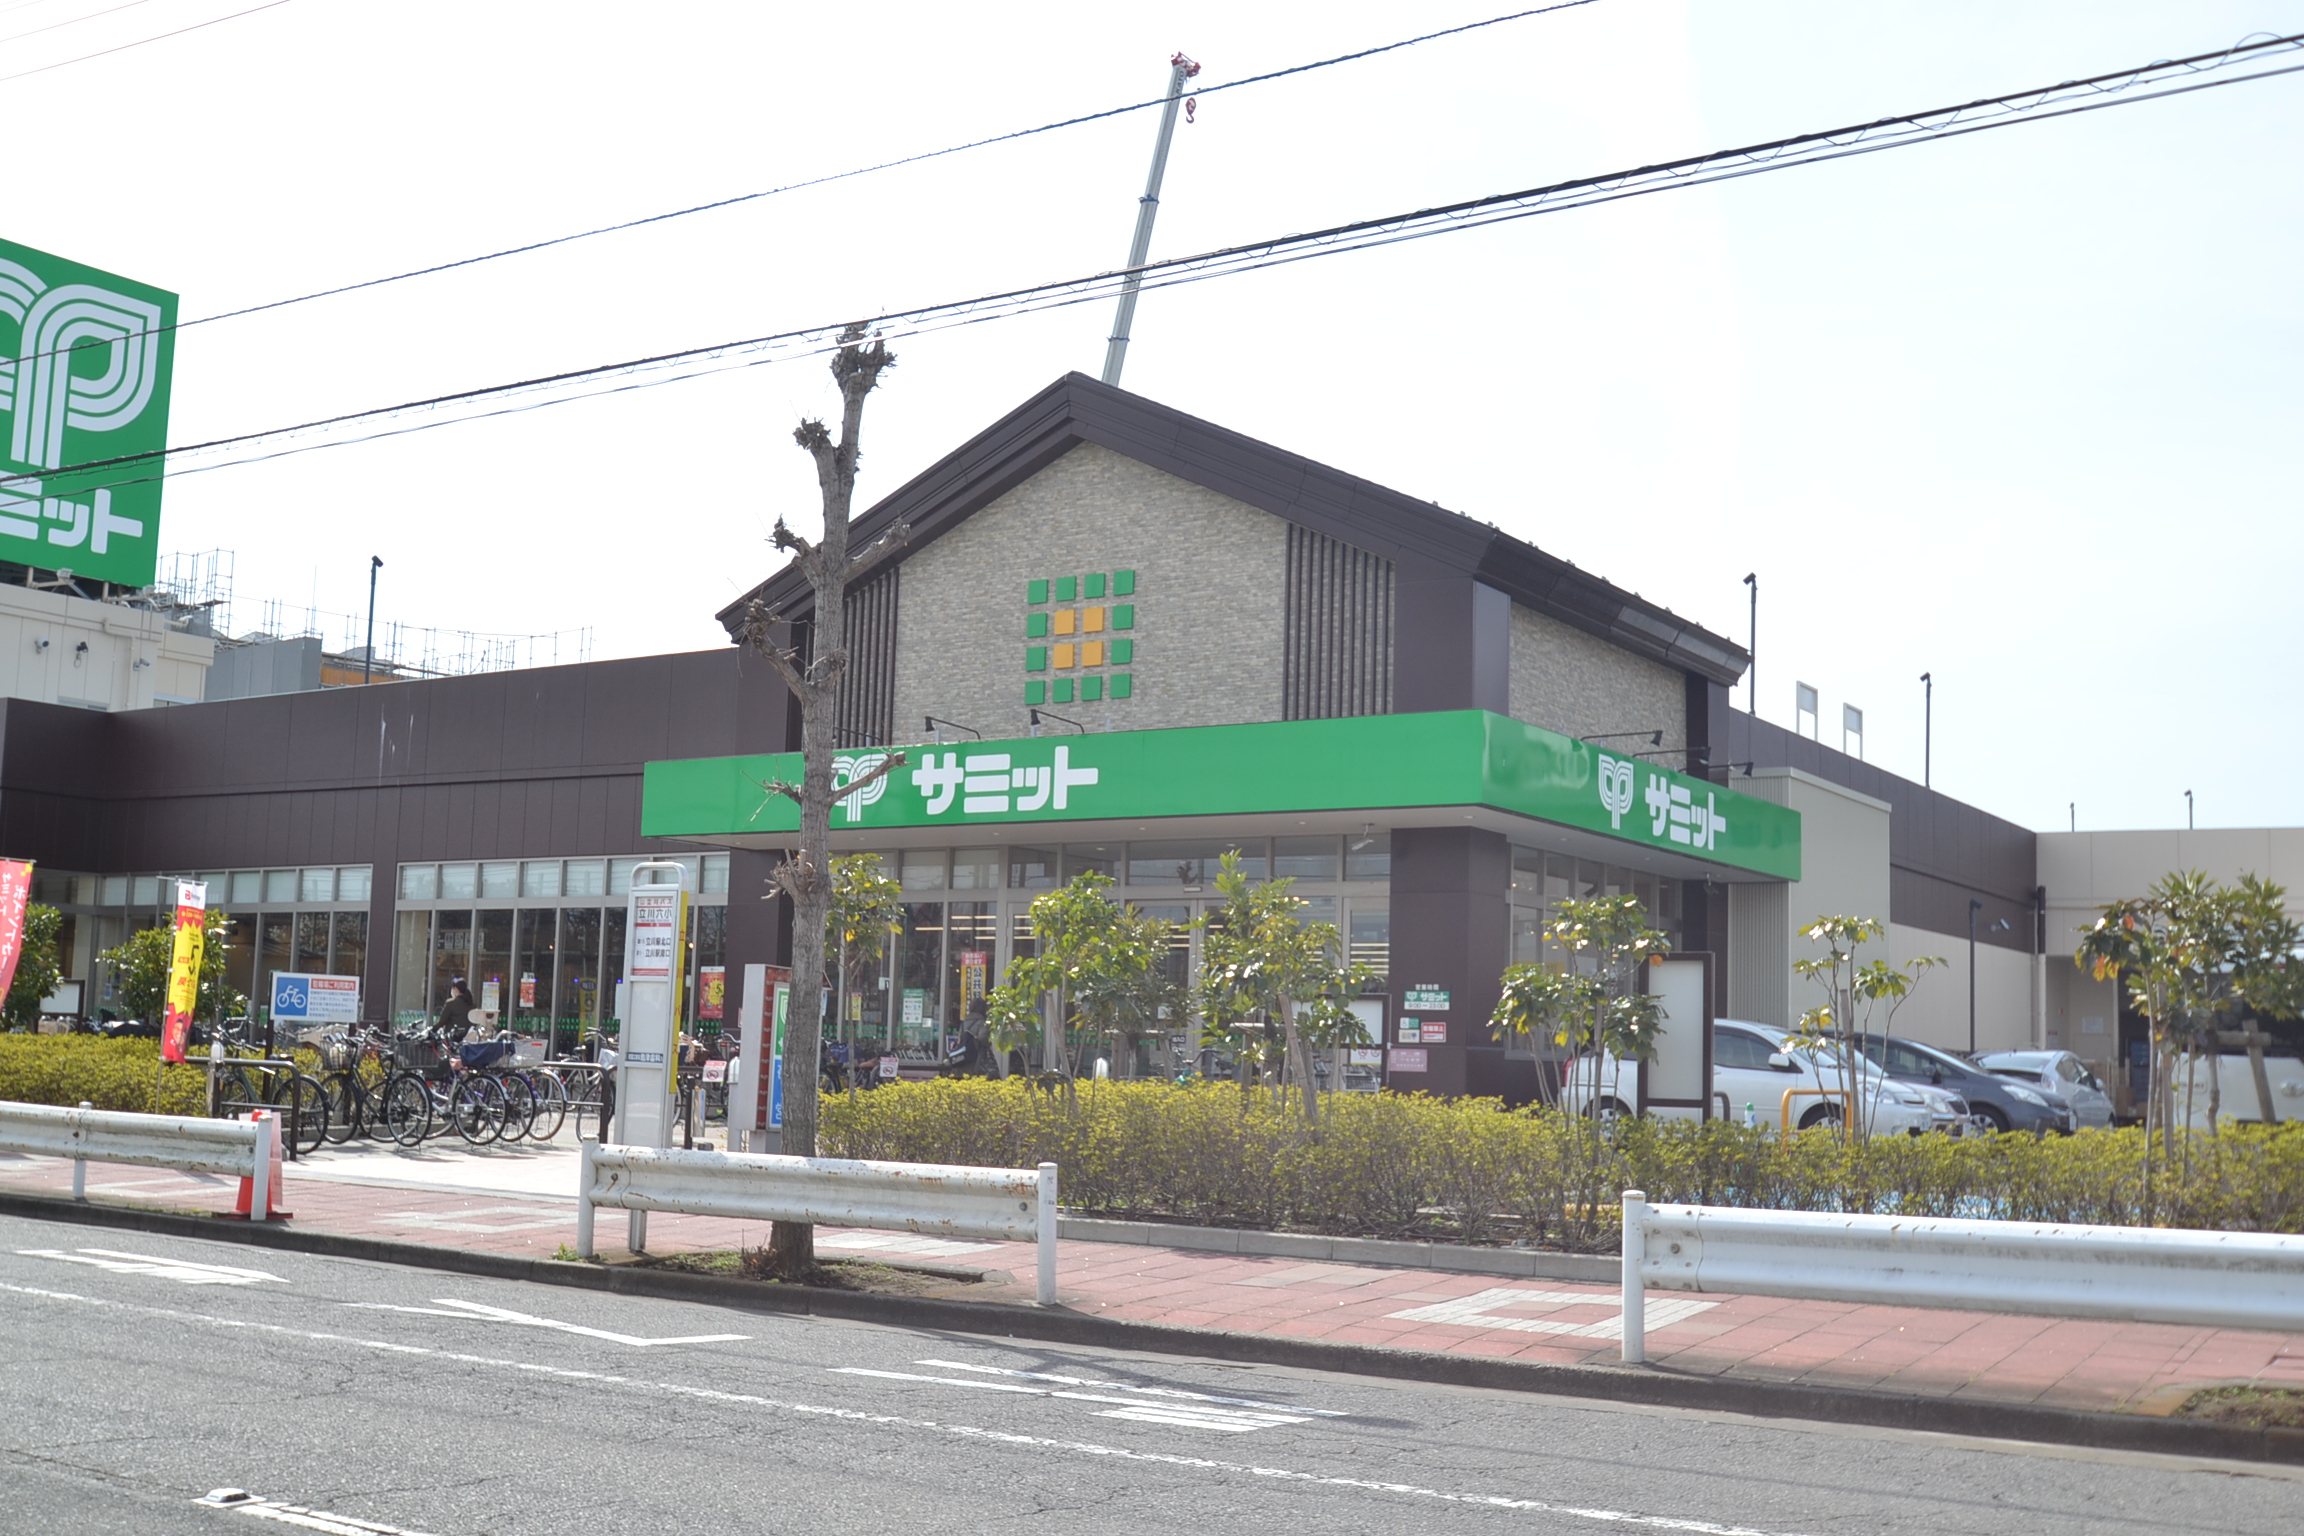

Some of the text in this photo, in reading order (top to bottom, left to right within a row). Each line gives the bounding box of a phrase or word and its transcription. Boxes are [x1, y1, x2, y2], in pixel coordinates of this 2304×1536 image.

[1175, 70, 1185, 95] KATO
[912, 746, 1098, 815] サミット
[1645, 773, 1726, 851] サミット
[638, 908, 672, 919] 立川六小
[645, 937, 671, 946] 立川駅北口
[672, 930, 685, 1055] 立川バス
[1420, 992, 1448, 1002] サミット
